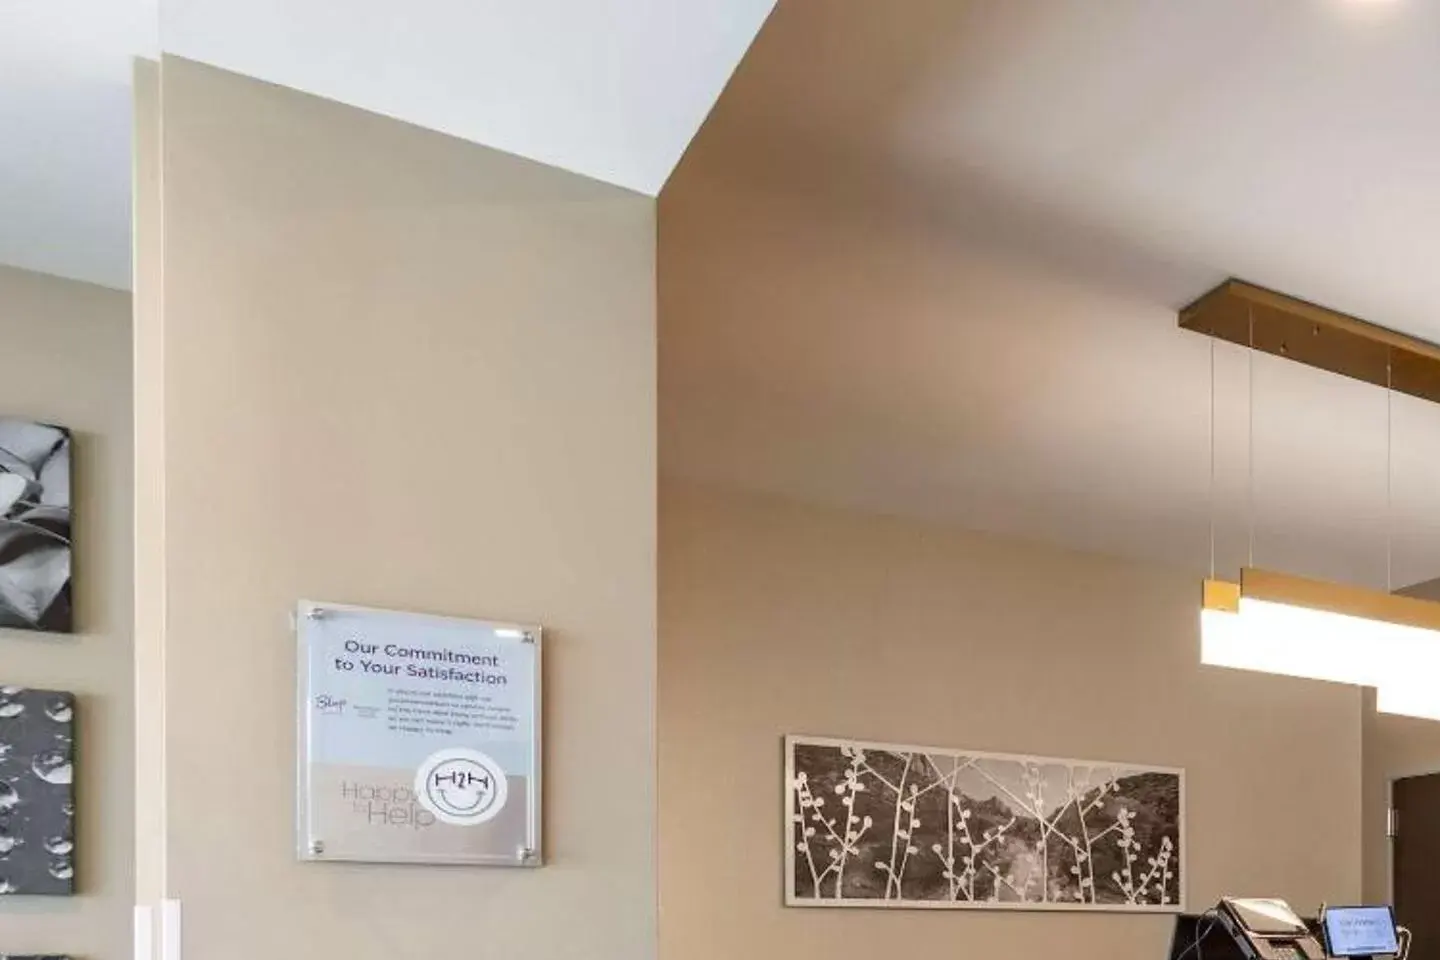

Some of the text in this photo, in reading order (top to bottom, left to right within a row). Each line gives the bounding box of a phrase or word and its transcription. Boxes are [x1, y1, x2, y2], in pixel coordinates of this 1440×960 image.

[345, 640, 499, 667] Our Commitment
[334, 658, 508, 685] to Your Satisfaction
[435, 771, 488, 789] H2H
[368, 801, 437, 831] Help
